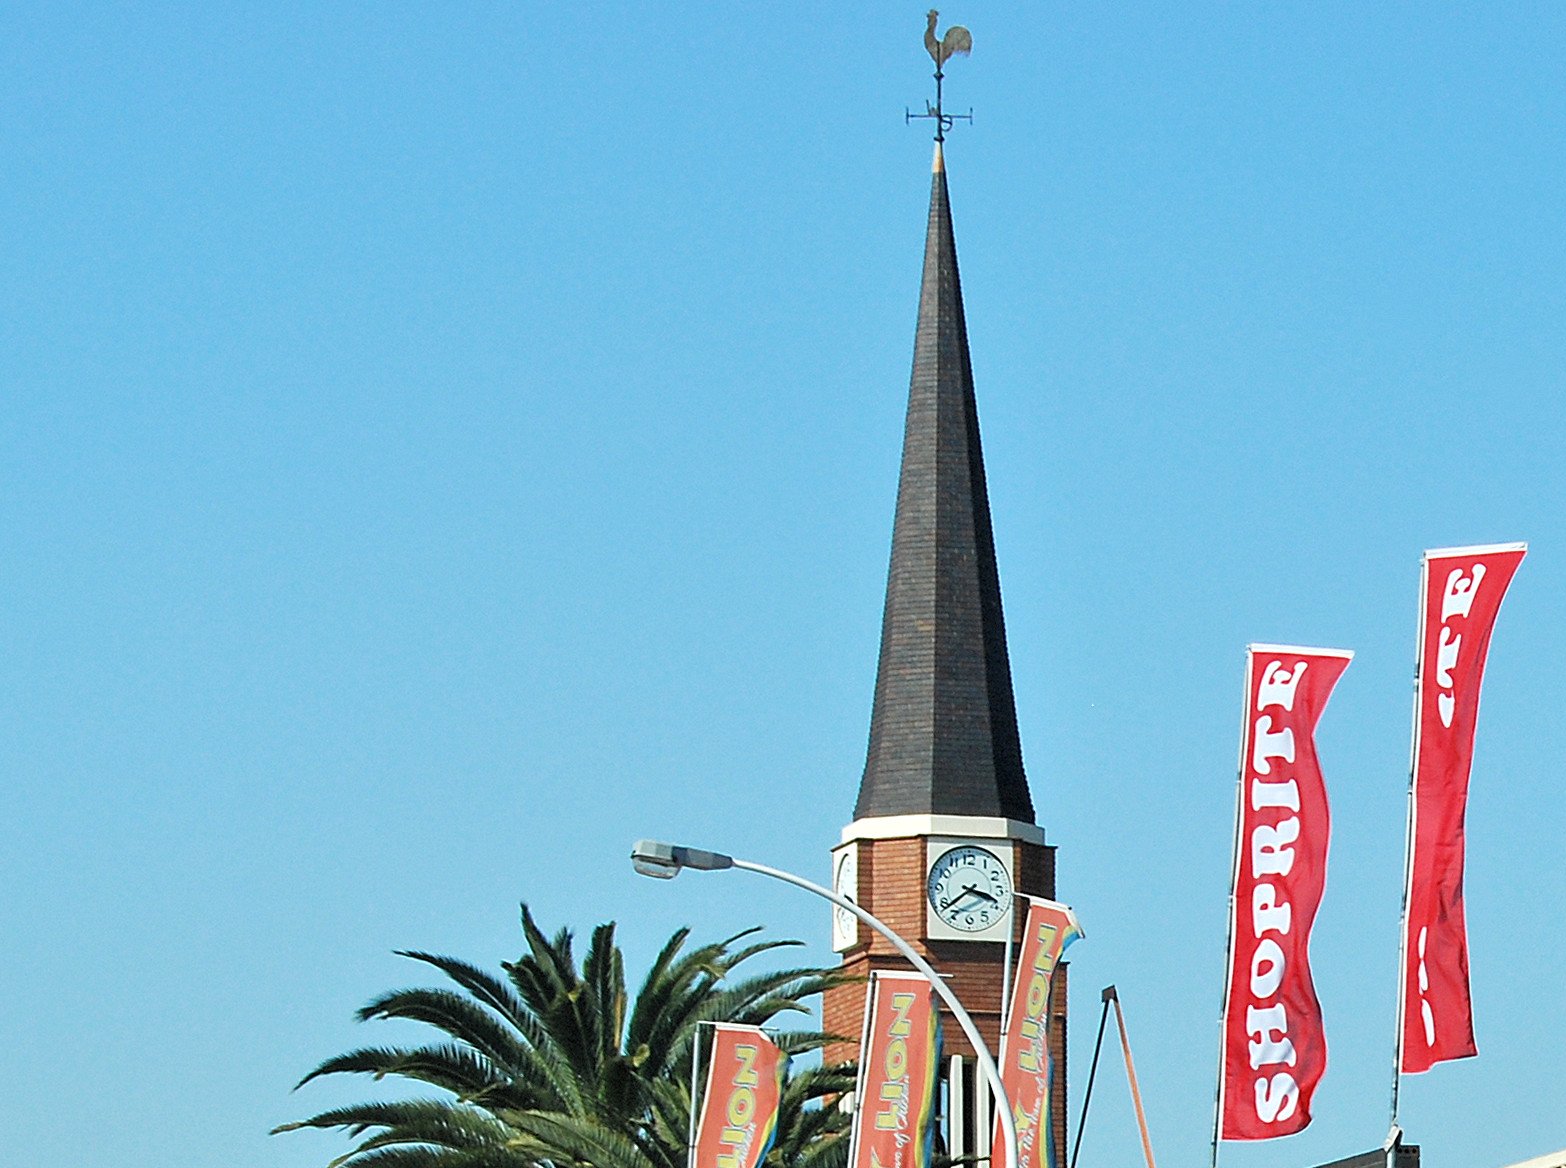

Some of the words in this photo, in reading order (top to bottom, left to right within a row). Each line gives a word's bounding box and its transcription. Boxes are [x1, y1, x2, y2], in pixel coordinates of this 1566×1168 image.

[962, 854, 976, 866] 12
[982, 856, 988, 869] 1
[990, 871, 1000, 881] 2
[935, 883, 944, 894] 9
[995, 886, 1004, 896] 3
[1245, 658, 1308, 1124] SHOPRITE
[965, 914, 974, 925] 6
[980, 910, 990, 923] 5
[1019, 923, 1058, 1073] LION
[875, 992, 916, 1130] LION
[894, 1132, 912, 1149] of
